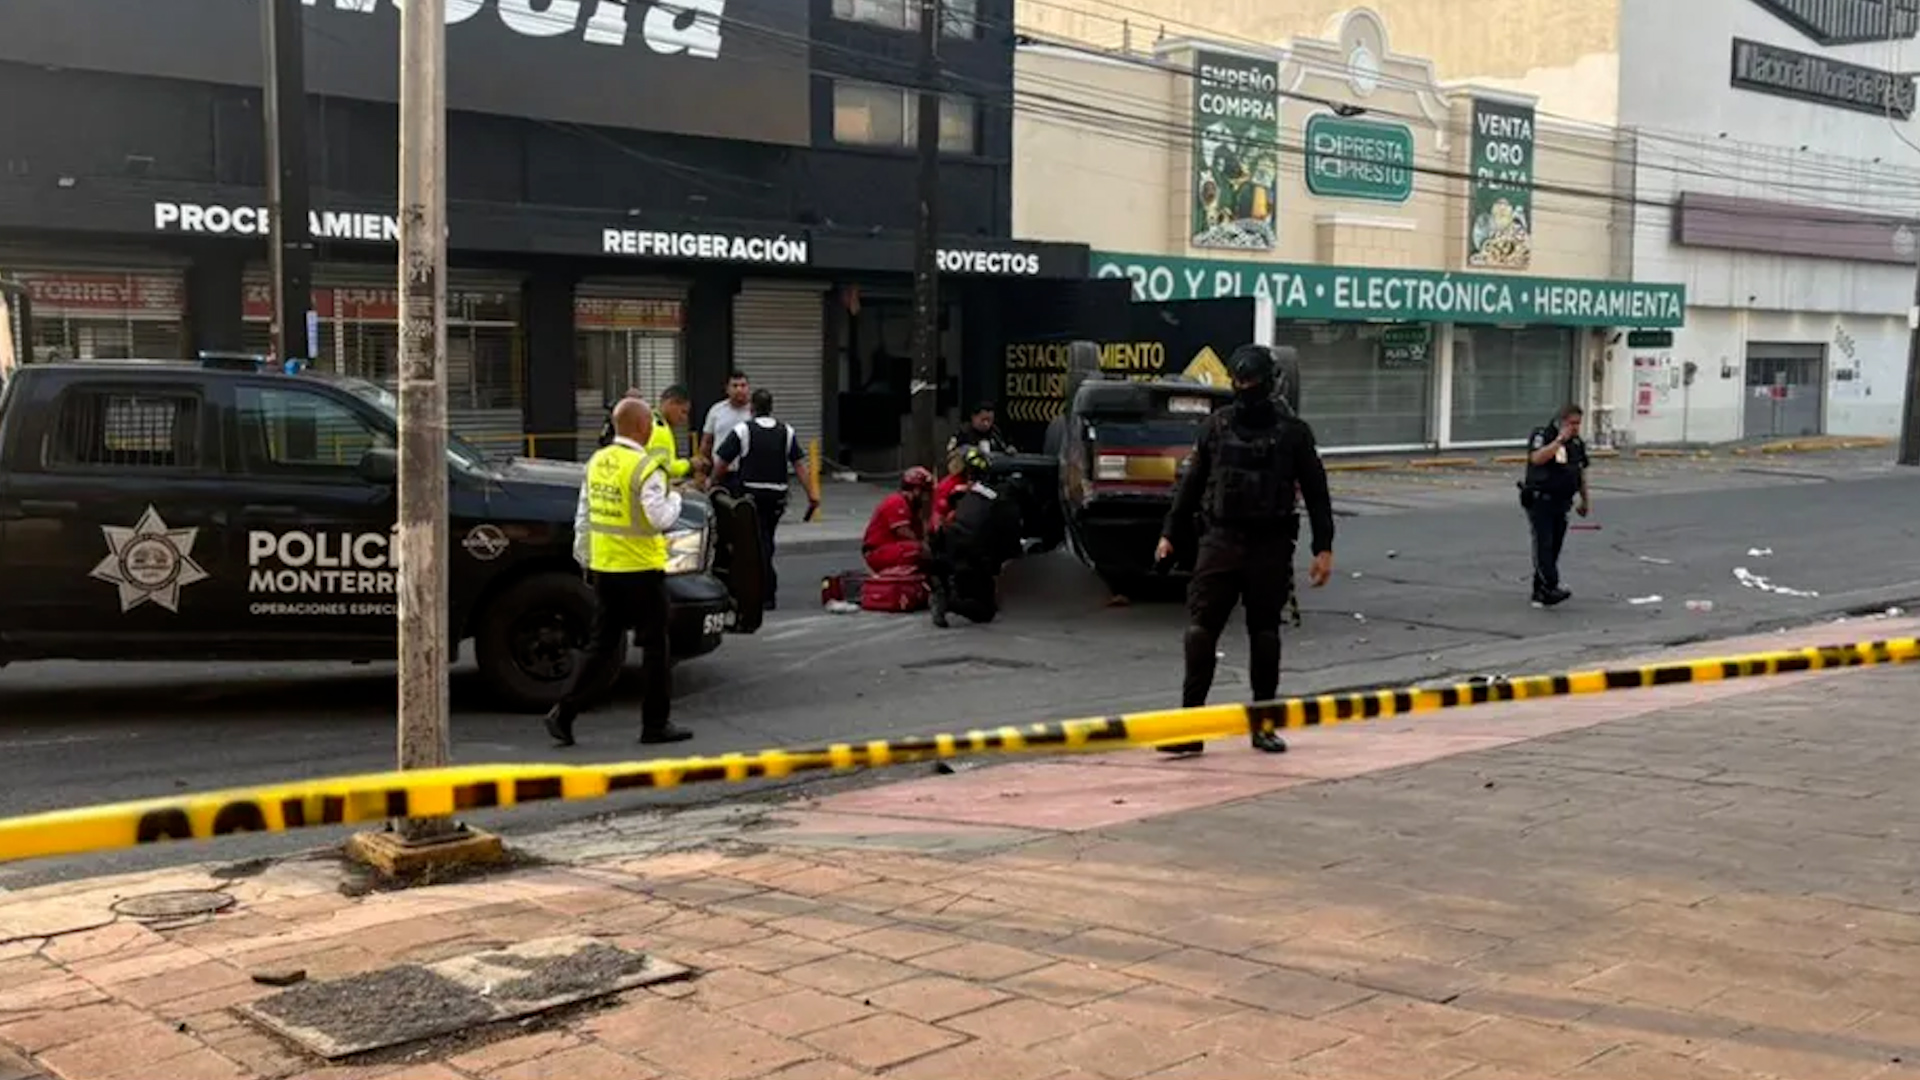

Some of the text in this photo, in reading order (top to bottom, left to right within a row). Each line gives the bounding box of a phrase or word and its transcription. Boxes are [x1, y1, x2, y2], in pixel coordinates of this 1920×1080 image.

[1200, 64, 1276, 92] EMPEÑO
[1199, 92, 1276, 121] COMPRA
[1477, 112, 1532, 140] VENTA
[1343, 135, 1405, 162] PRESTA
[1485, 140, 1524, 166] ORO
[603, 228, 808, 264] REFRIGERACIÓN
[936, 248, 1040, 275] ROYECTOS
[1183, 268, 1206, 299] Y
[1333, 272, 1514, 314] ELECTRÓNICA
[1533, 285, 1682, 319] HERRAMIENTA
[1005, 341, 1166, 369] ESTACIOMIENTO
[248, 523, 399, 569] POLICÍ
[248, 570, 398, 594] MONTERR
[250, 602, 398, 615] OPERACIONES ESPECI
